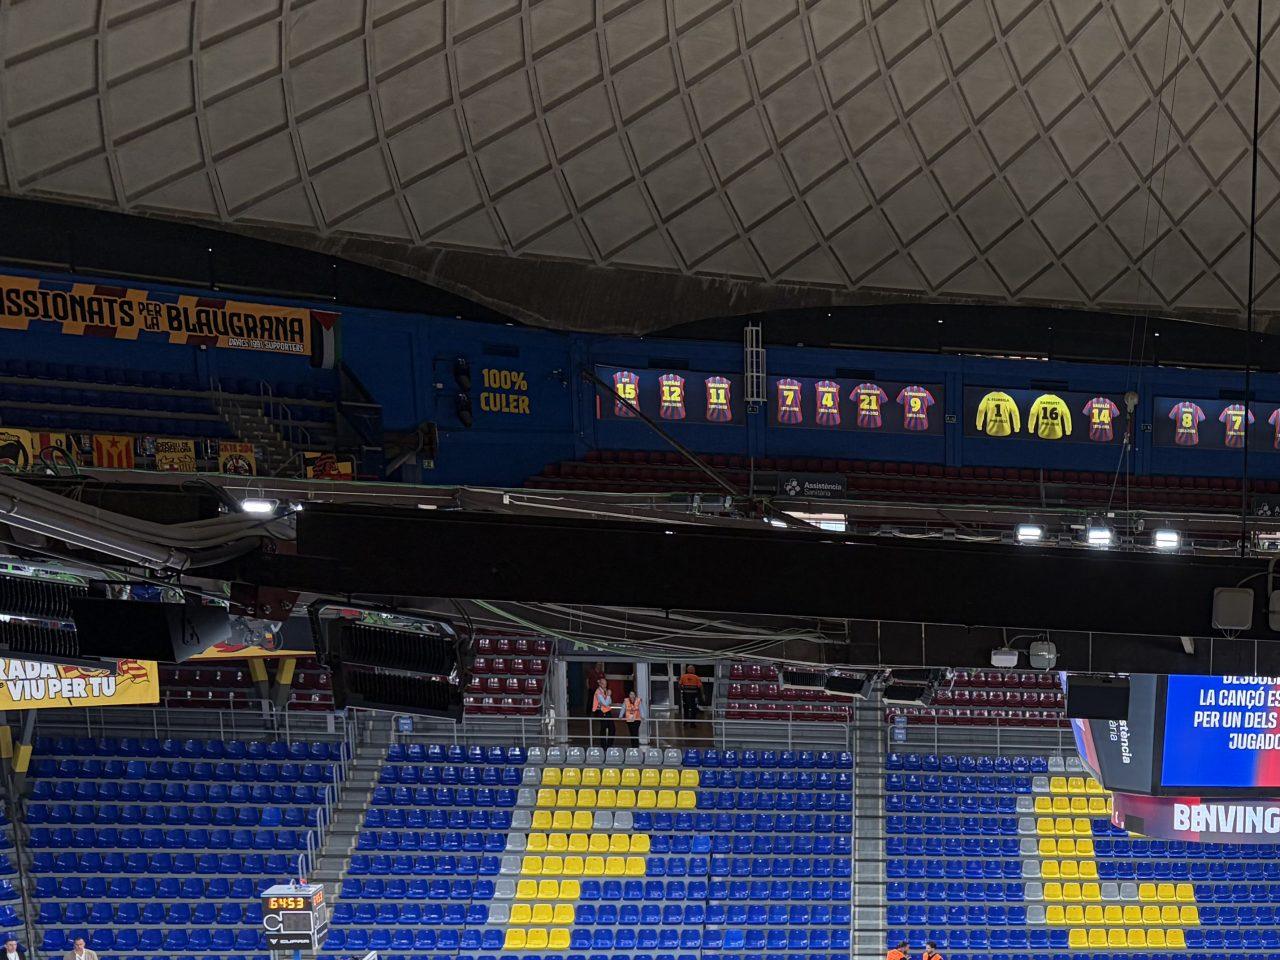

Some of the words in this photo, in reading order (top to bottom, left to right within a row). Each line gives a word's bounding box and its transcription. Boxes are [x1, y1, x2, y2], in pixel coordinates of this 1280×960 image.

[0, 287, 134, 327] SSIONATS
[138, 302, 162, 317] PER
[144, 317, 160, 330] LA
[166, 304, 304, 342] BLAUGRANA
[482, 368, 528, 391] 100%
[616, 383, 636, 399] 15
[662, 386, 681, 401] 12
[709, 388, 727, 404] 11
[783, 391, 795, 405] 7
[481, 391, 530, 415] CULER
[822, 393, 834, 407] 4
[859, 395, 878, 410] 21
[910, 398, 921, 412] 9
[994, 403, 1002, 417] 1
[1041, 406, 1059, 421] 16
[1091, 408, 1110, 424] 14
[1182, 413, 1192, 428] 8
[1232, 415, 1242, 430] 7
[7, 679, 46, 701] VIU
[48, 678, 88, 699] PER
[89, 676, 116, 697] TU
[1200, 689, 1215, 706] LA
[1218, 687, 1265, 709] CANÇÓ
[1194, 711, 1219, 728] PER
[1222, 712, 1242, 728] UN
[1244, 712, 1277, 729] DELS
[1118, 719, 1133, 764] stència
